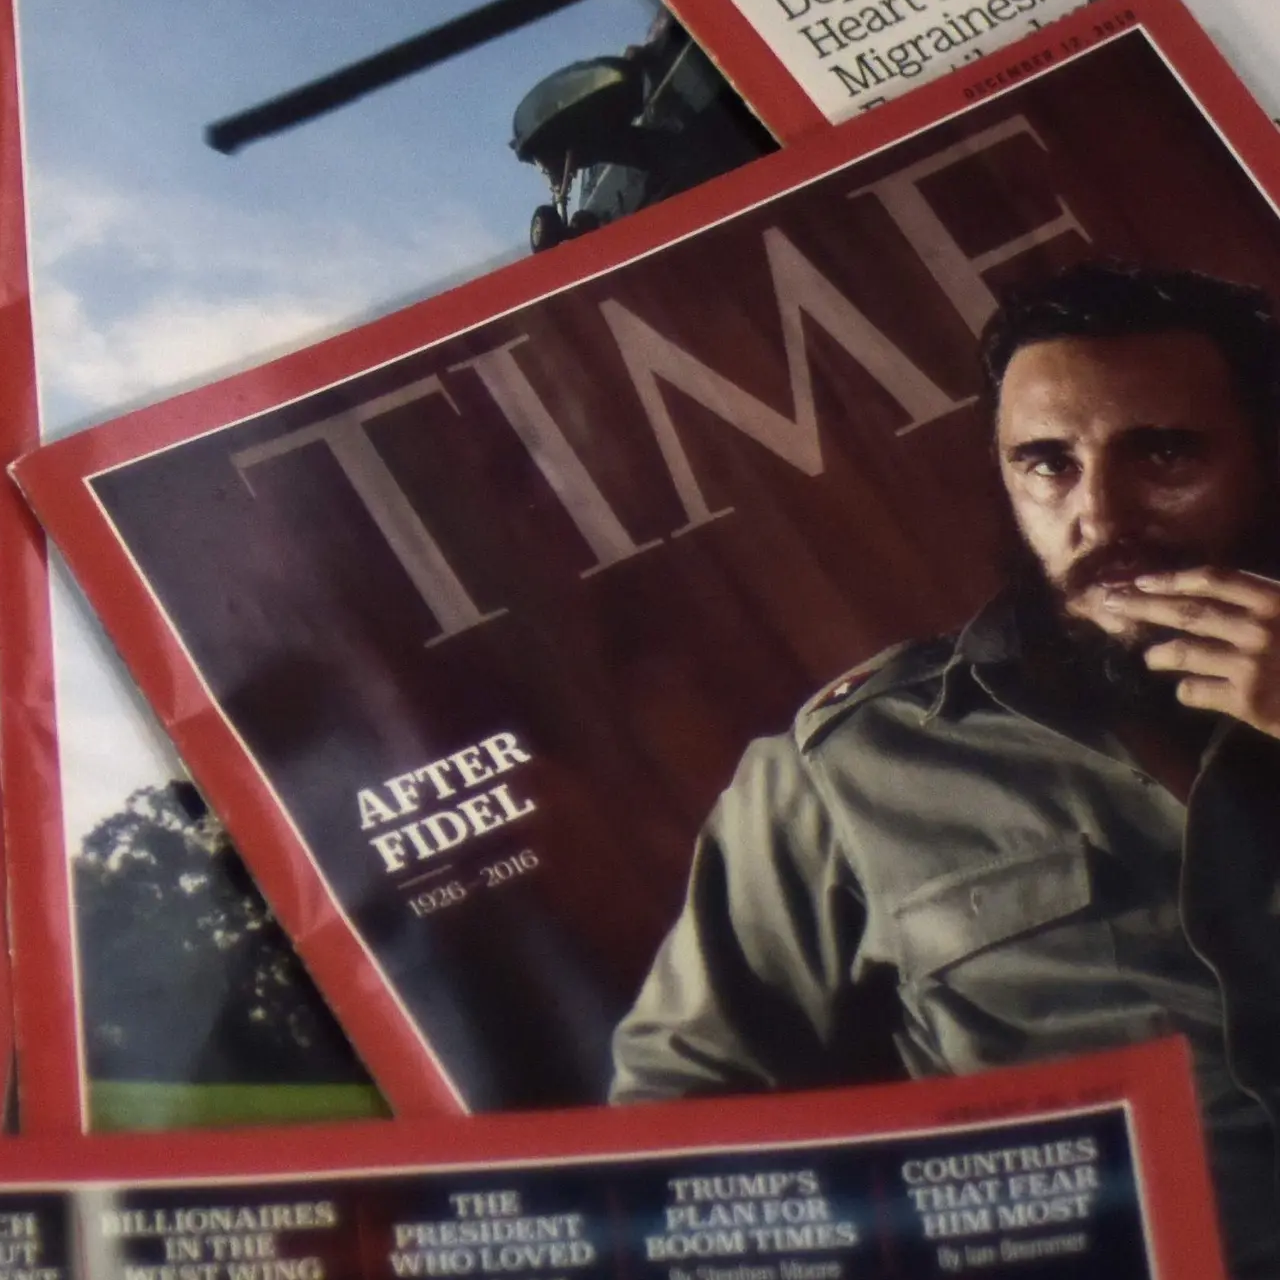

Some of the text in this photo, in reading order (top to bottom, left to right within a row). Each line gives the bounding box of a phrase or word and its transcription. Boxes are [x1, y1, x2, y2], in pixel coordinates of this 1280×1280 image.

[230, 114, 1096, 648] TIME
[357, 731, 532, 830] AFTER
[369, 784, 536, 873] FIDEL
[901, 1137, 1098, 1185] COUNTRIES
[450, 1190, 521, 1218] THE
[668, 1170, 819, 1203] TRUMP'S
[907, 1165, 1099, 1213] THAT FEAR
[101, 1201, 336, 1237] BILLIONAIRES
[394, 1214, 582, 1249] PRESIDENT
[665, 1197, 829, 1231] PLAN FOR
[922, 1193, 1090, 1240] HIM MOST
[164, 1231, 275, 1262] IN THE
[390, 1240, 596, 1278] WHO LOVED
[645, 1222, 858, 1261] BOOM TIMES
